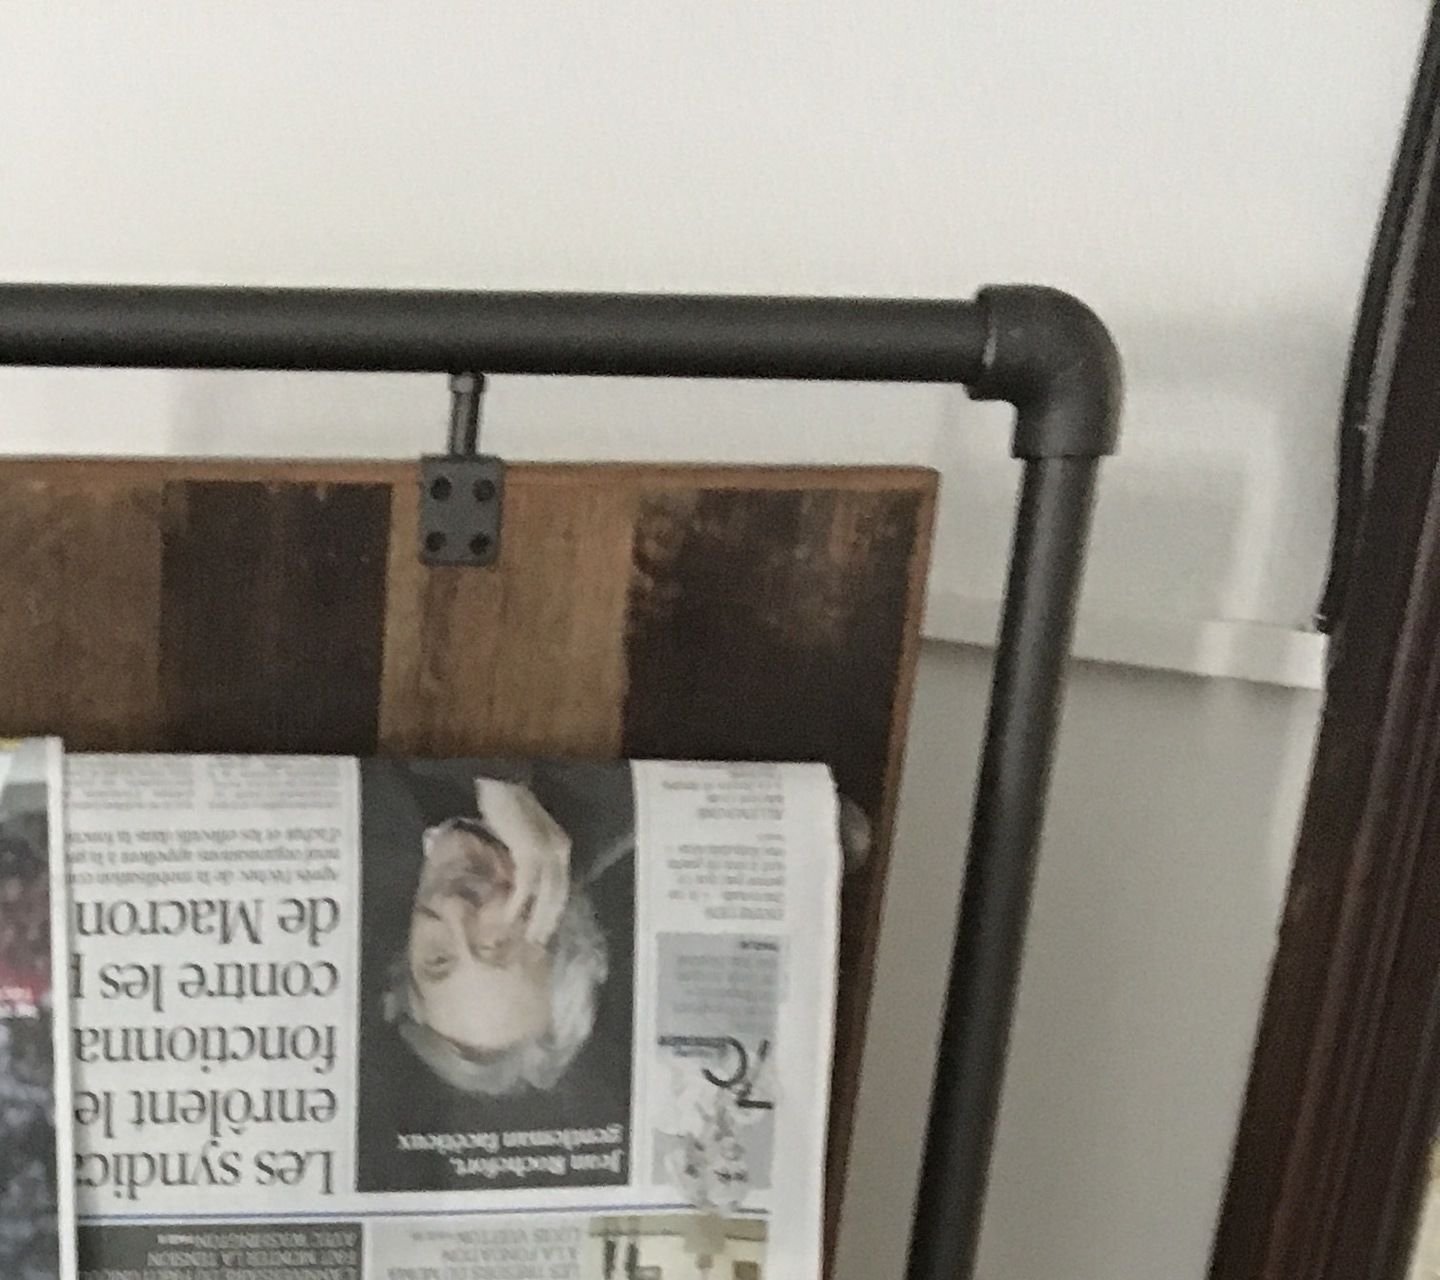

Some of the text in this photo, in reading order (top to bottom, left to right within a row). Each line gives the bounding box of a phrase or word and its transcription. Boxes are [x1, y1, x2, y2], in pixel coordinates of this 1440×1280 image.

[74, 897, 341, 947] de Macron
[97, 962, 165, 1013] les
[177, 961, 340, 1003] contre
[127, 1088, 338, 1140] enrôlent
[254, 1150, 334, 1196] Les
